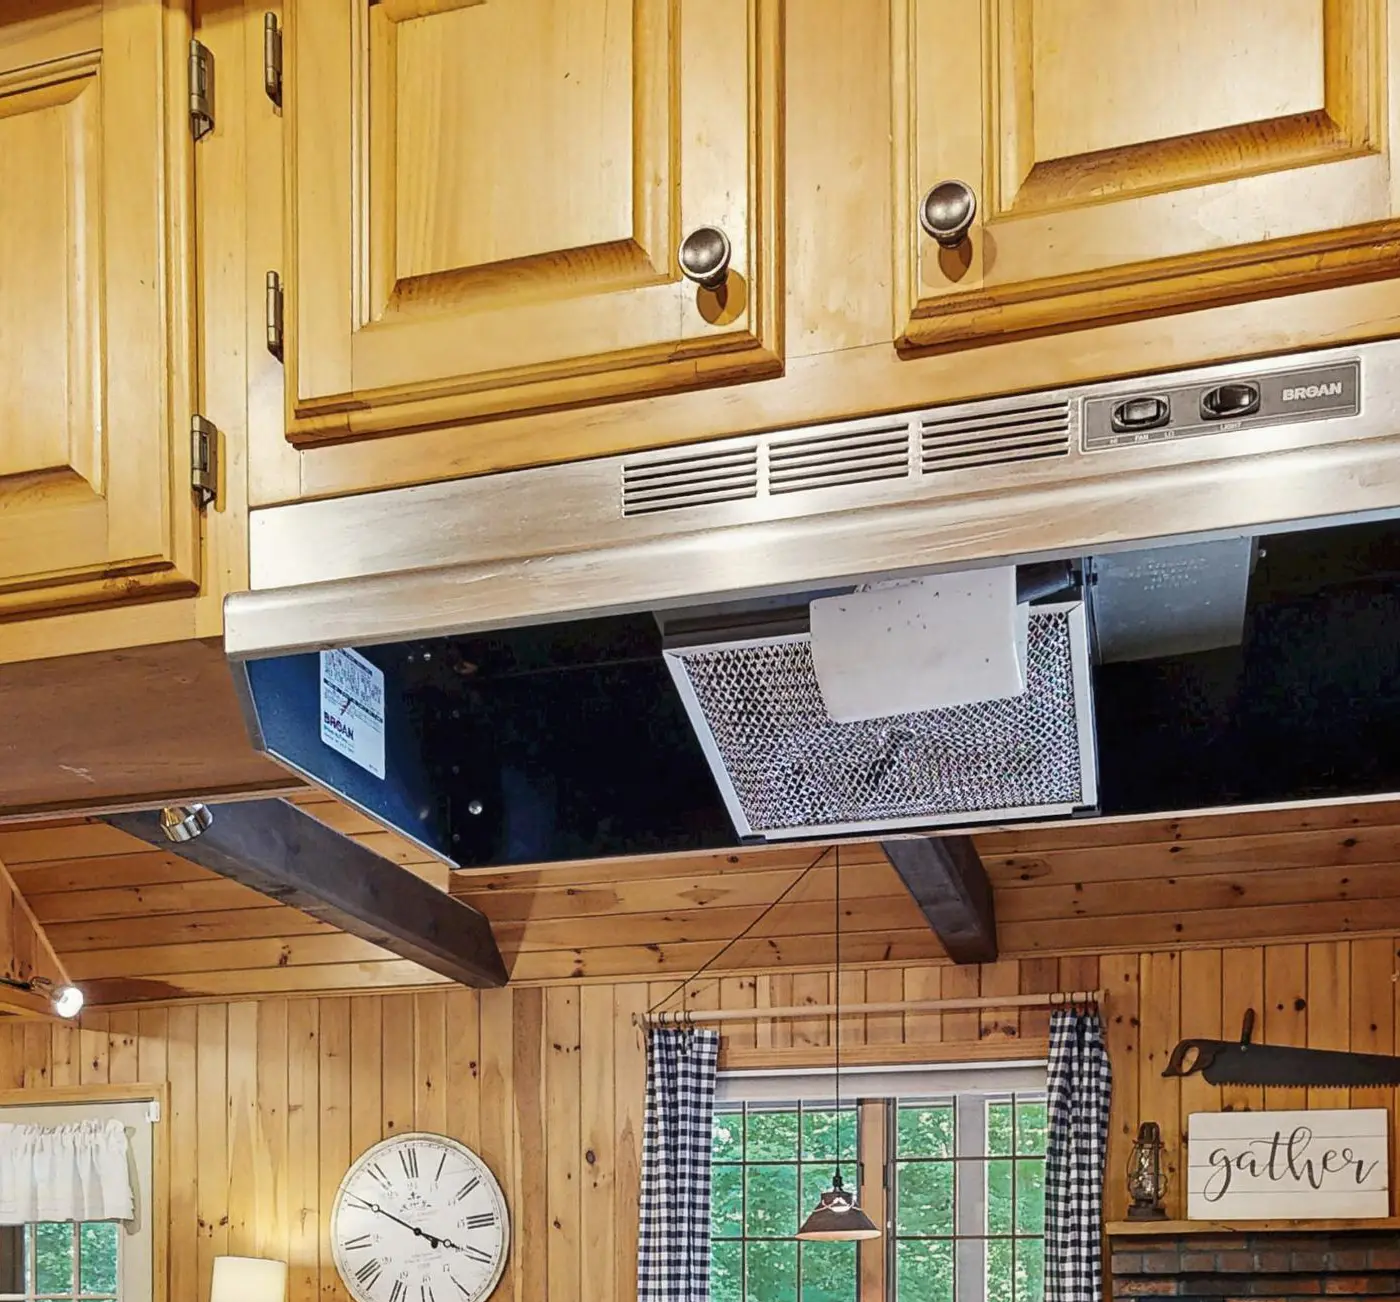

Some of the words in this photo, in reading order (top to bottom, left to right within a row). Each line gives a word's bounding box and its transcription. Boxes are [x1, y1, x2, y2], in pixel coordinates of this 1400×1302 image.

[1282, 381, 1342, 402] BROAN
[324, 711, 354, 741] BROAN
[1203, 1126, 1380, 1202] gather
